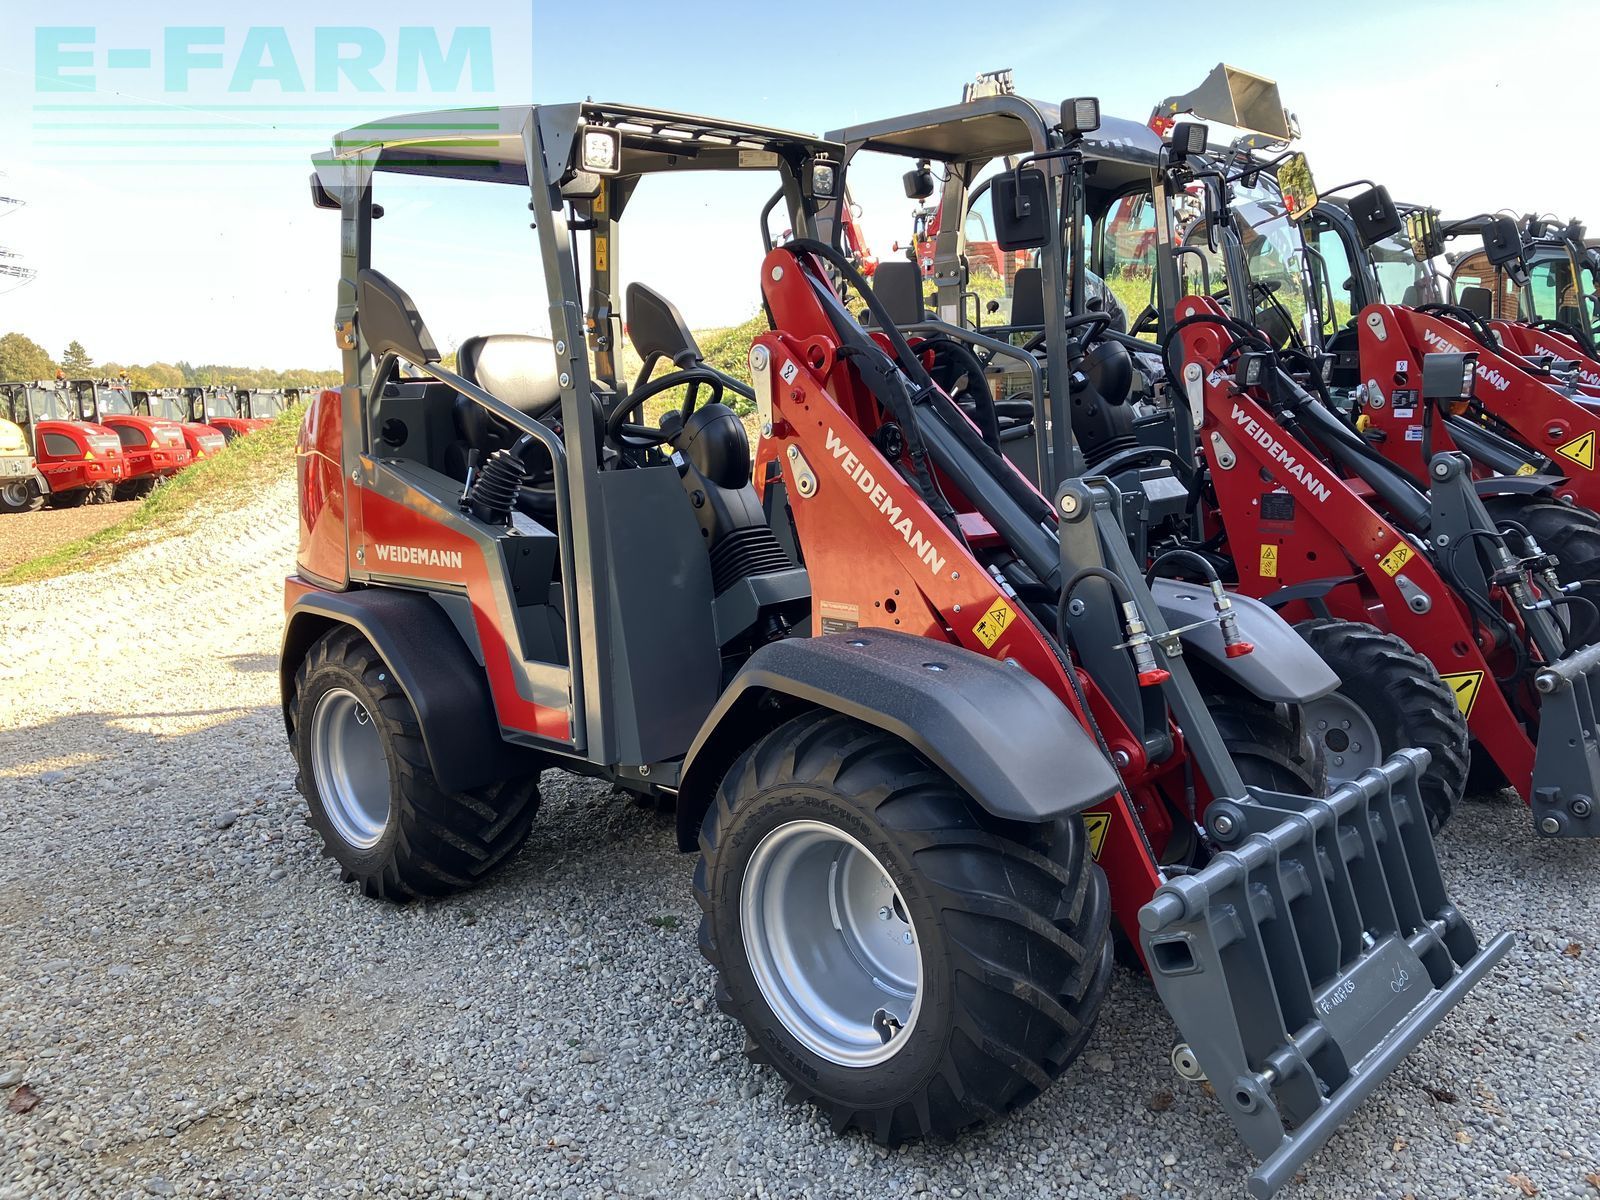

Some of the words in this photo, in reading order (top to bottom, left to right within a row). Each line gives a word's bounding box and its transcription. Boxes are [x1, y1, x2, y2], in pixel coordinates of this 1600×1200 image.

[825, 427, 946, 575] WEIDEMANN
[1231, 403, 1332, 502] WEIDEMANN
[375, 544, 462, 568] WEIDEMANN
